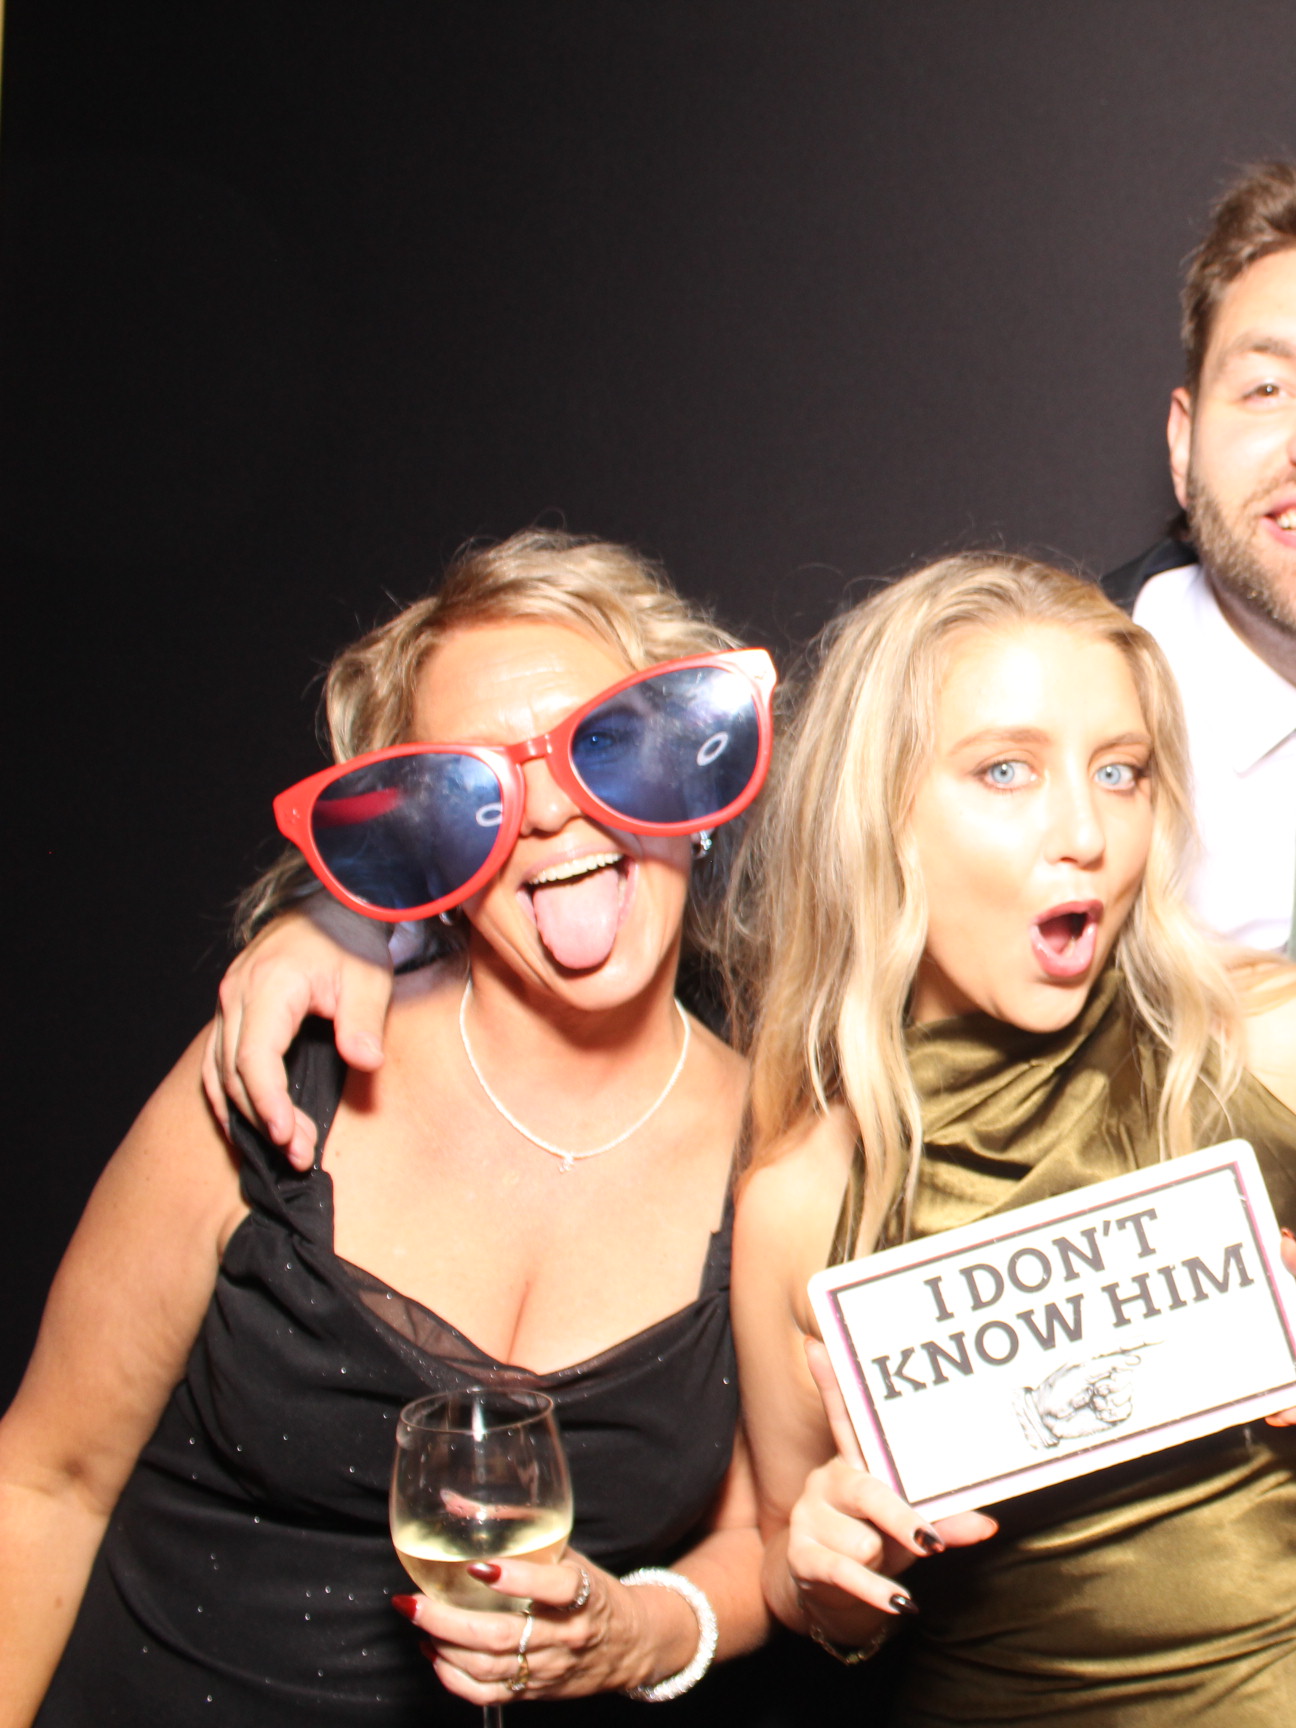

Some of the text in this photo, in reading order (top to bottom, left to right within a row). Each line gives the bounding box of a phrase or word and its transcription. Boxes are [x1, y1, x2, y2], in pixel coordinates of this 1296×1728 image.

[872, 1243, 1254, 1400] KNOW HIM
[925, 1208, 1158, 1322] I DON'T
